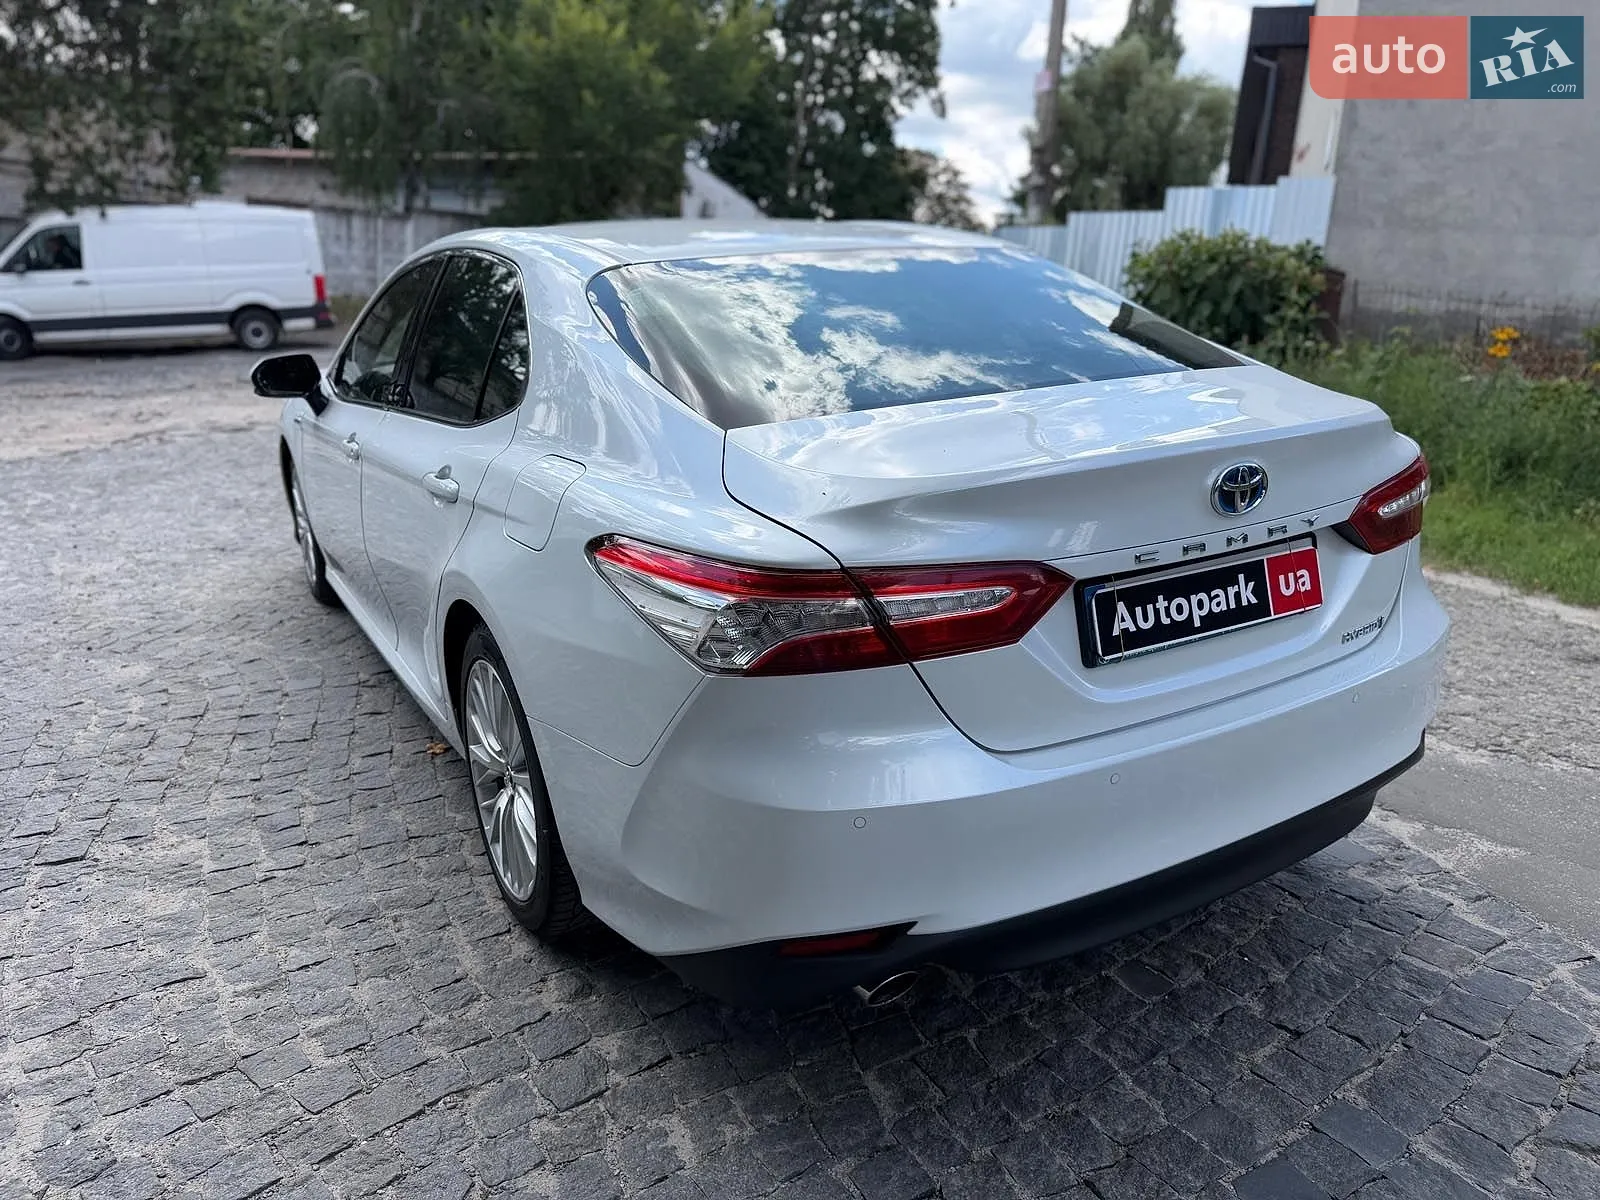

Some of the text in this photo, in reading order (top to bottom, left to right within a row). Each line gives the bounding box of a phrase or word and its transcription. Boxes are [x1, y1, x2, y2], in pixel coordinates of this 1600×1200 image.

[1134, 514, 1321, 564] CAMRY
[1113, 568, 1312, 636] Autopark ua
